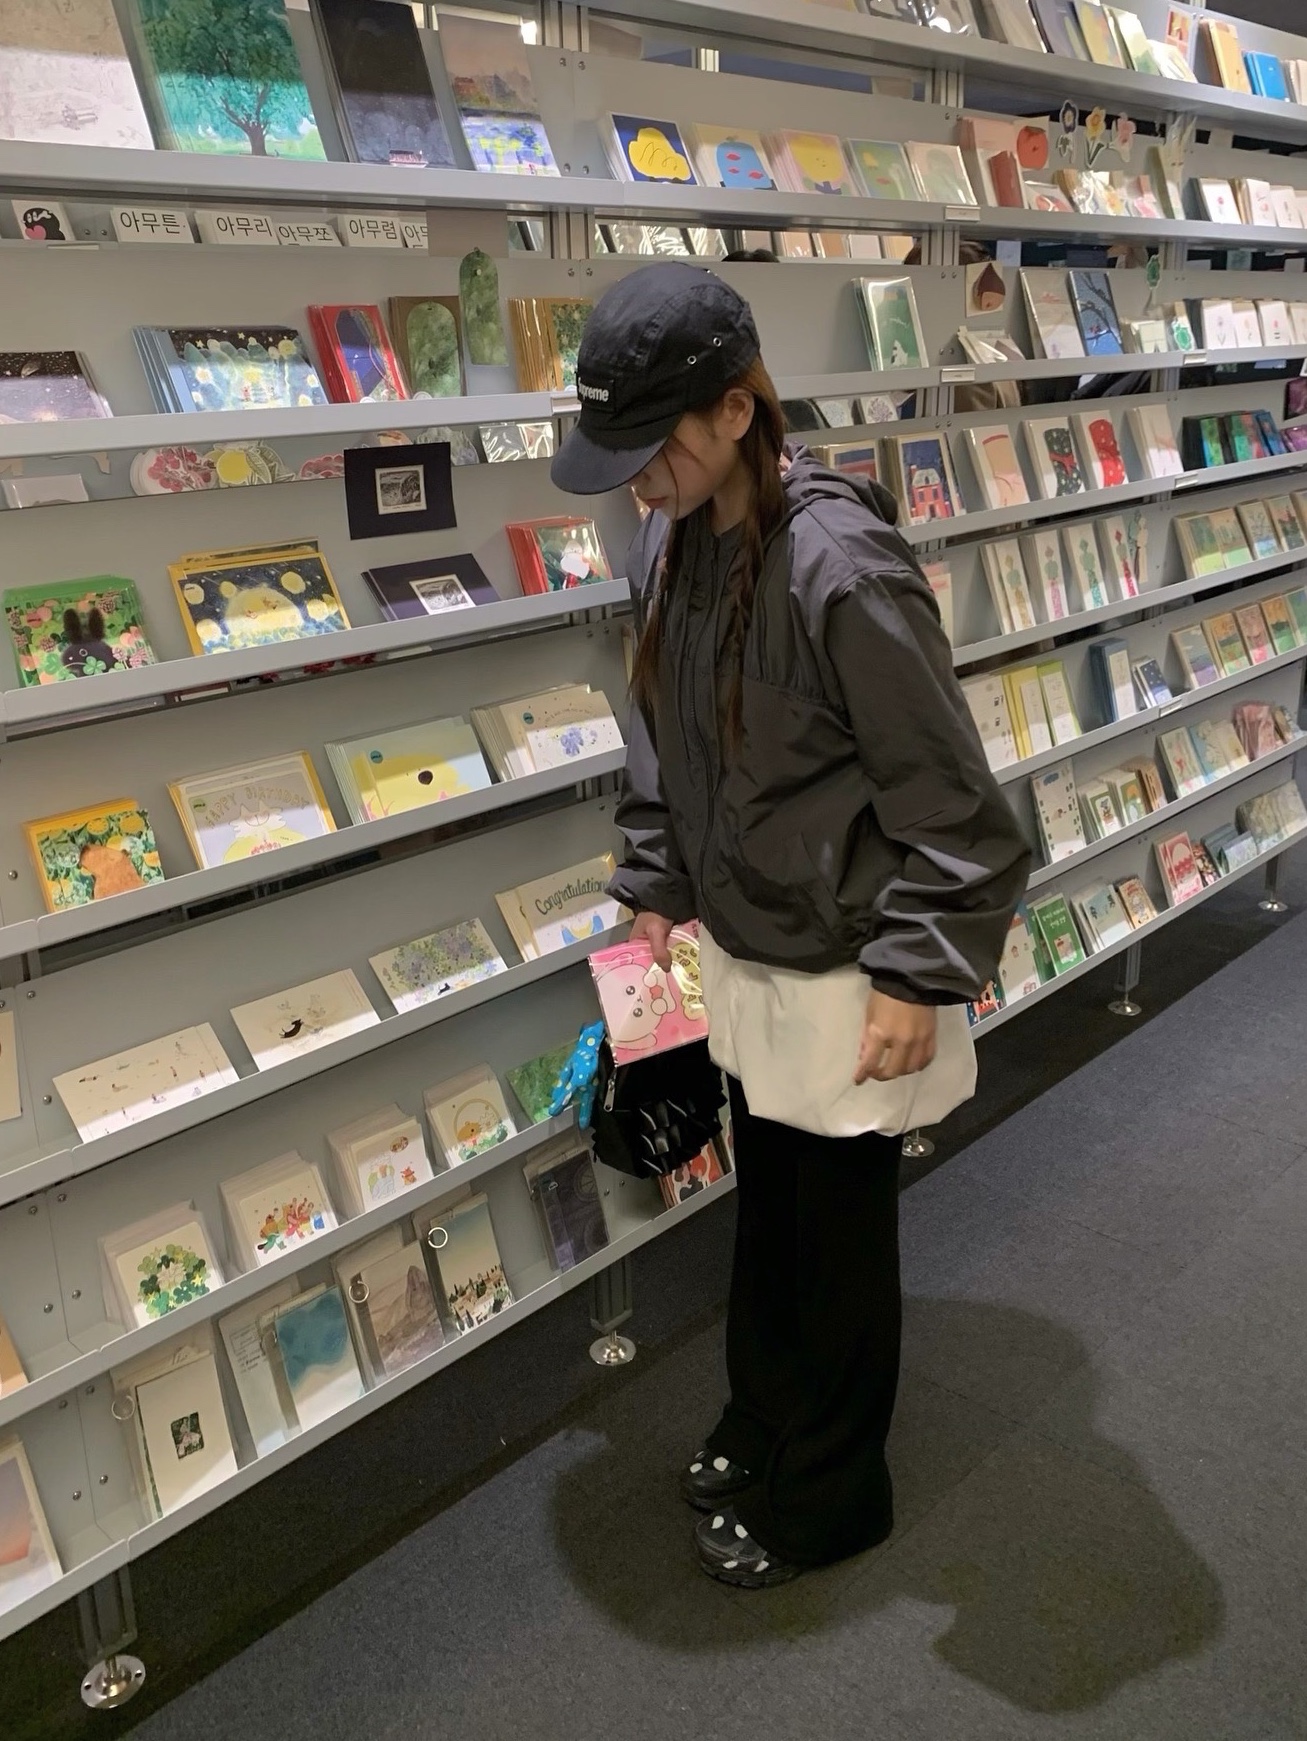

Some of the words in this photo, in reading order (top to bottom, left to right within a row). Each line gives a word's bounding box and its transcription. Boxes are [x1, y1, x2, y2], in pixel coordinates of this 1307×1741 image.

[216, 216, 272, 237] 아무리
[278, 223, 333, 242] 아무쪼
[350, 218, 398, 240] 아무렴
[578, 377, 610, 402] upreme
[534, 877, 609, 915] Congratulation
